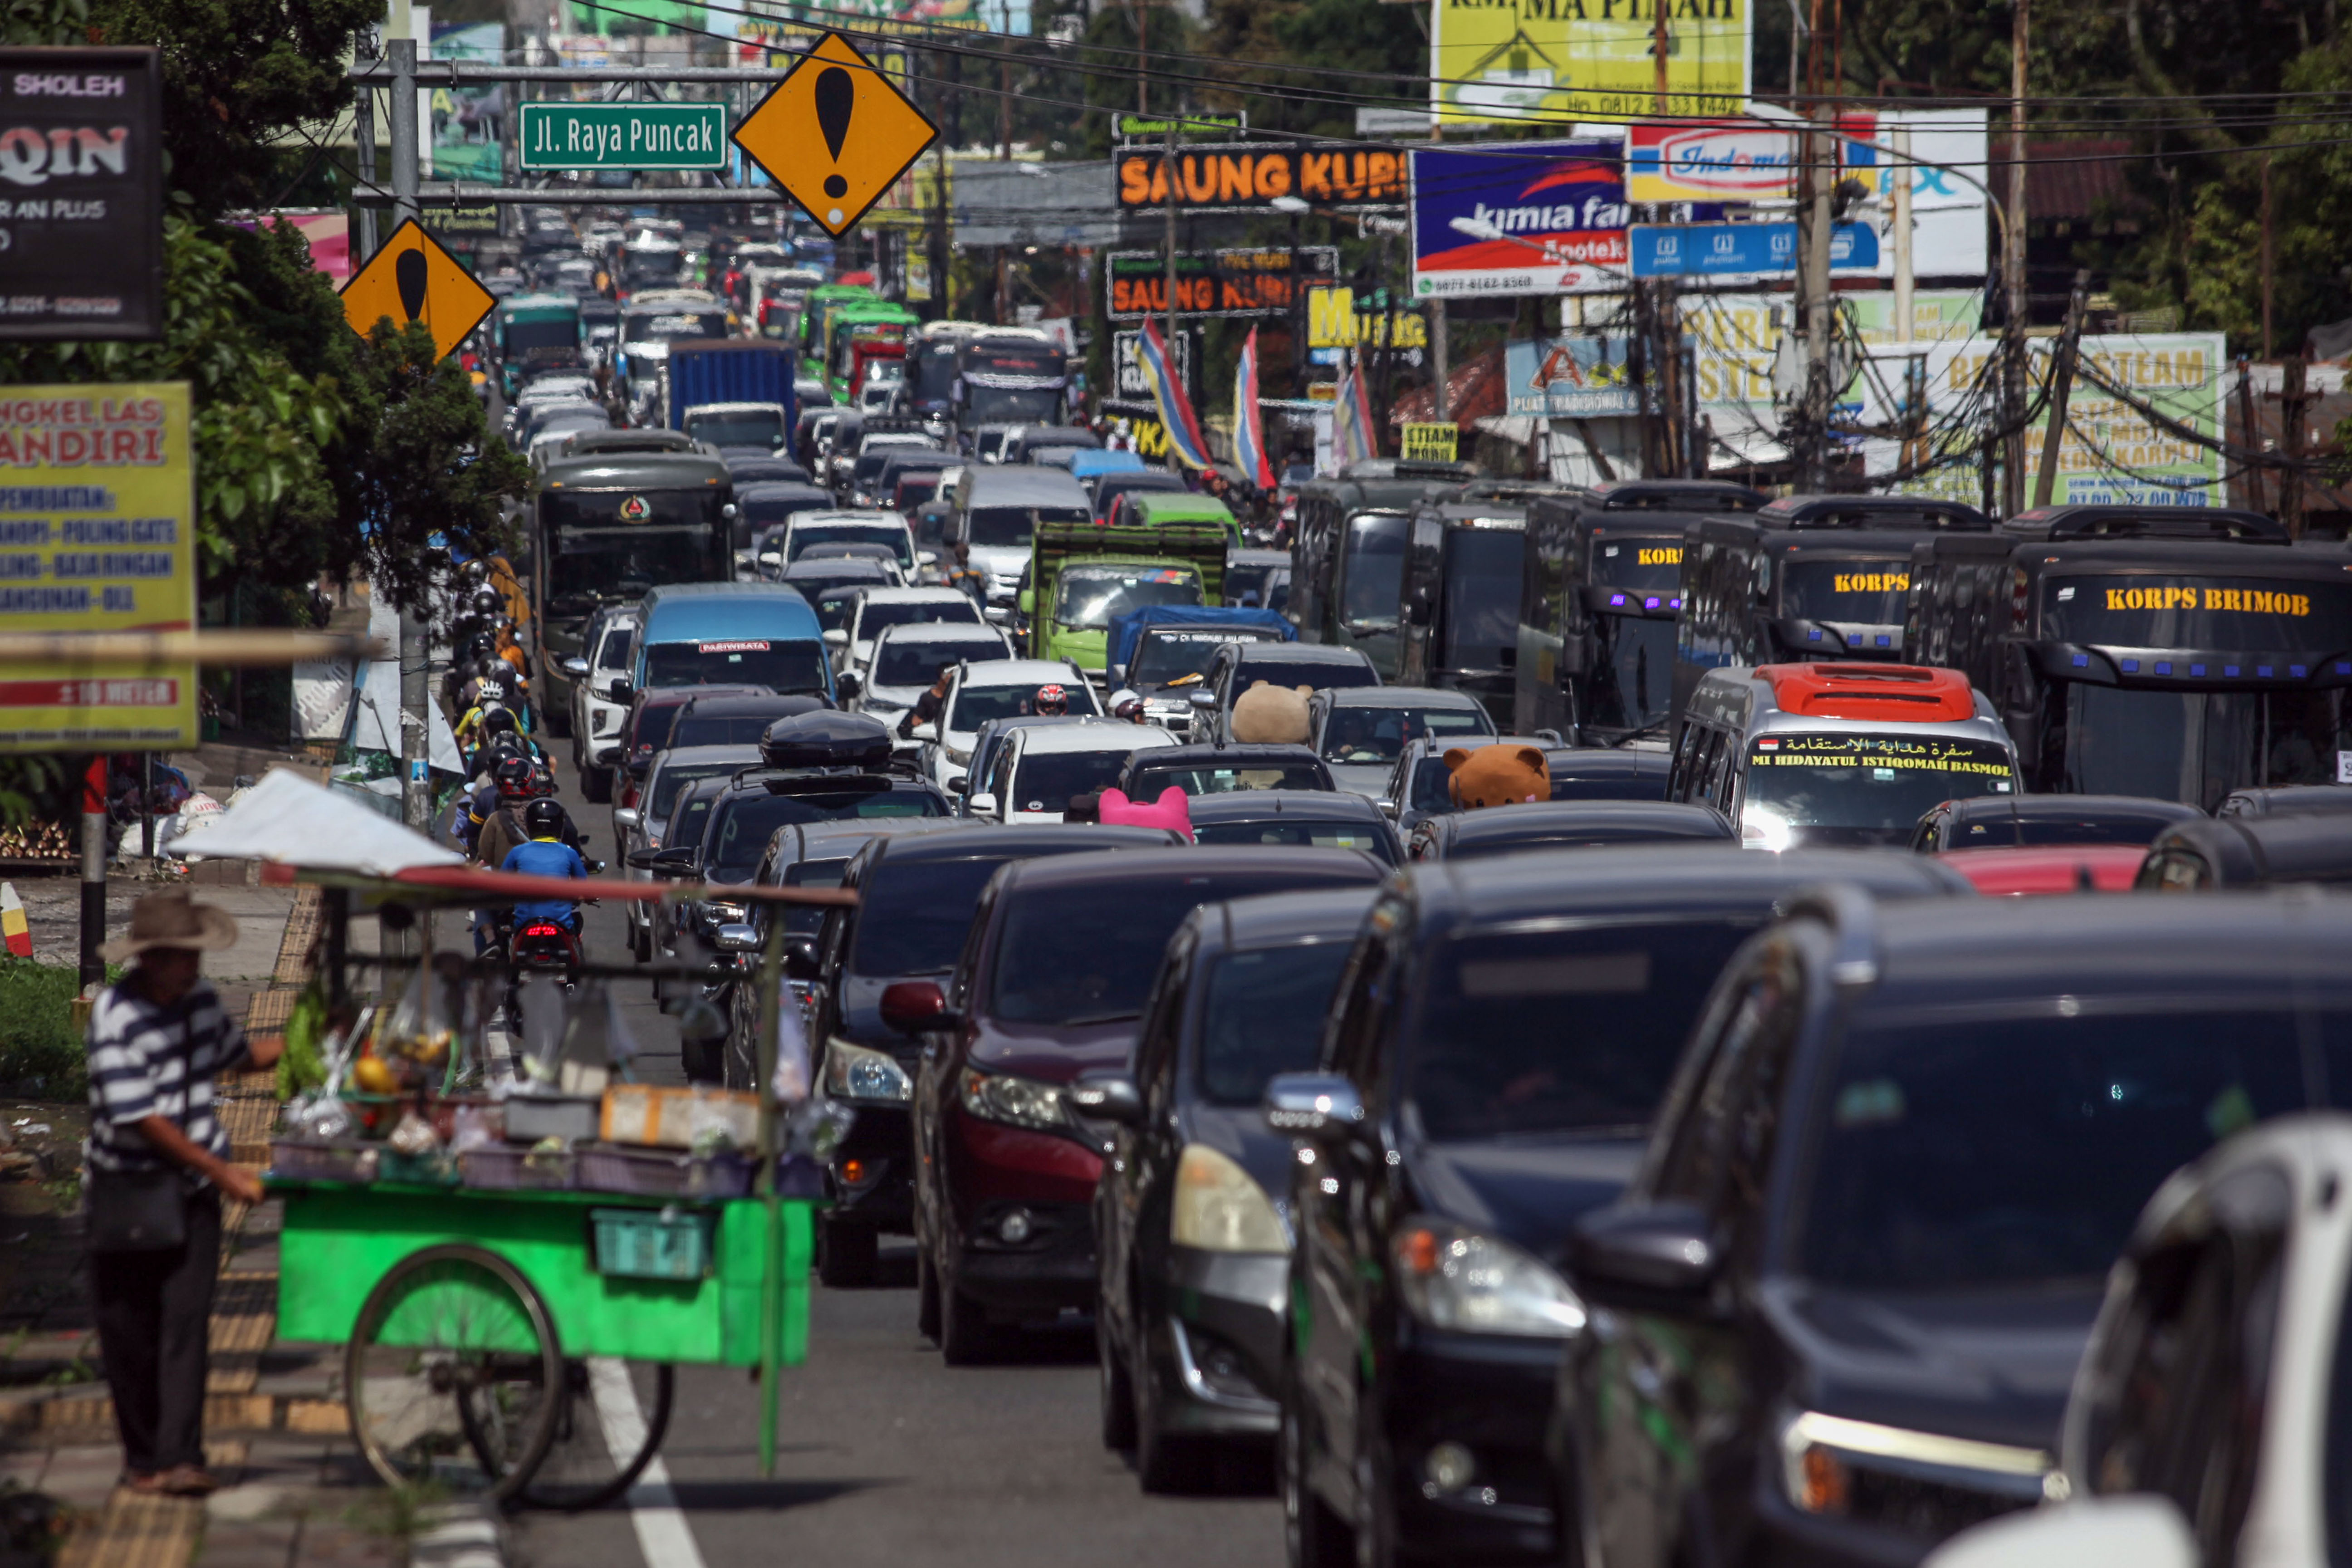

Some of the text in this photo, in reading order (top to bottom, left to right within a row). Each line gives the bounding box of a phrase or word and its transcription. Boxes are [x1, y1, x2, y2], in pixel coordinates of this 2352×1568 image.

[14, 74, 124, 97] SHOLEH
[534, 116, 713, 161] Jl. Raya Puncak
[1121, 154, 1292, 204] SAUNG
[53, 200, 106, 219] PLUS
[1113, 276, 1214, 311] SAUNG
[103, 399, 160, 422] LAS
[1834, 573, 1910, 593] KORPS
[2106, 587, 2311, 616] KORPS BRIMOB
[1752, 755, 2012, 777] MI HIDAYATUL ISTIQOMAH BASMOL
